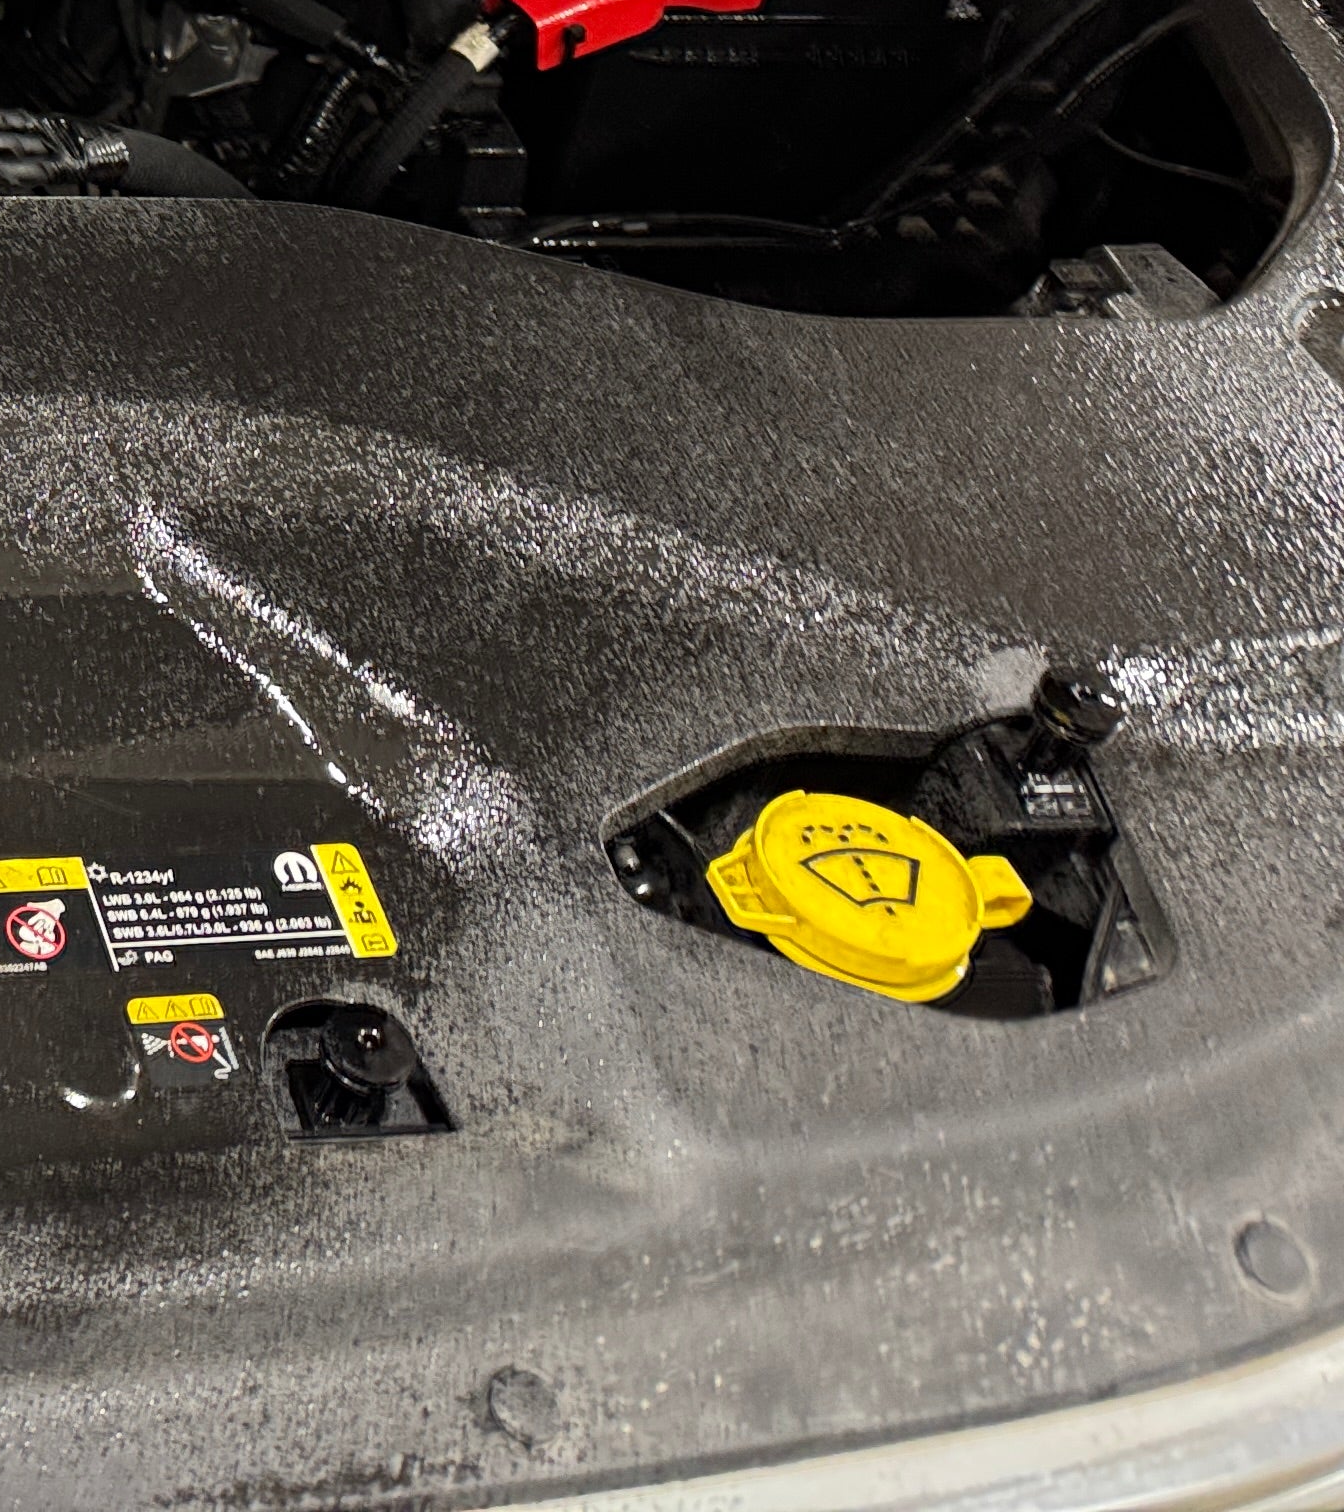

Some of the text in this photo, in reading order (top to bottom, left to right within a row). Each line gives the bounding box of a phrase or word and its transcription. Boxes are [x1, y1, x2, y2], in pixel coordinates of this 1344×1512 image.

[103, 893, 132, 906] LWB
[107, 909, 138, 922] SWB
[113, 926, 144, 939] SWB
[144, 950, 174, 963] PAG
